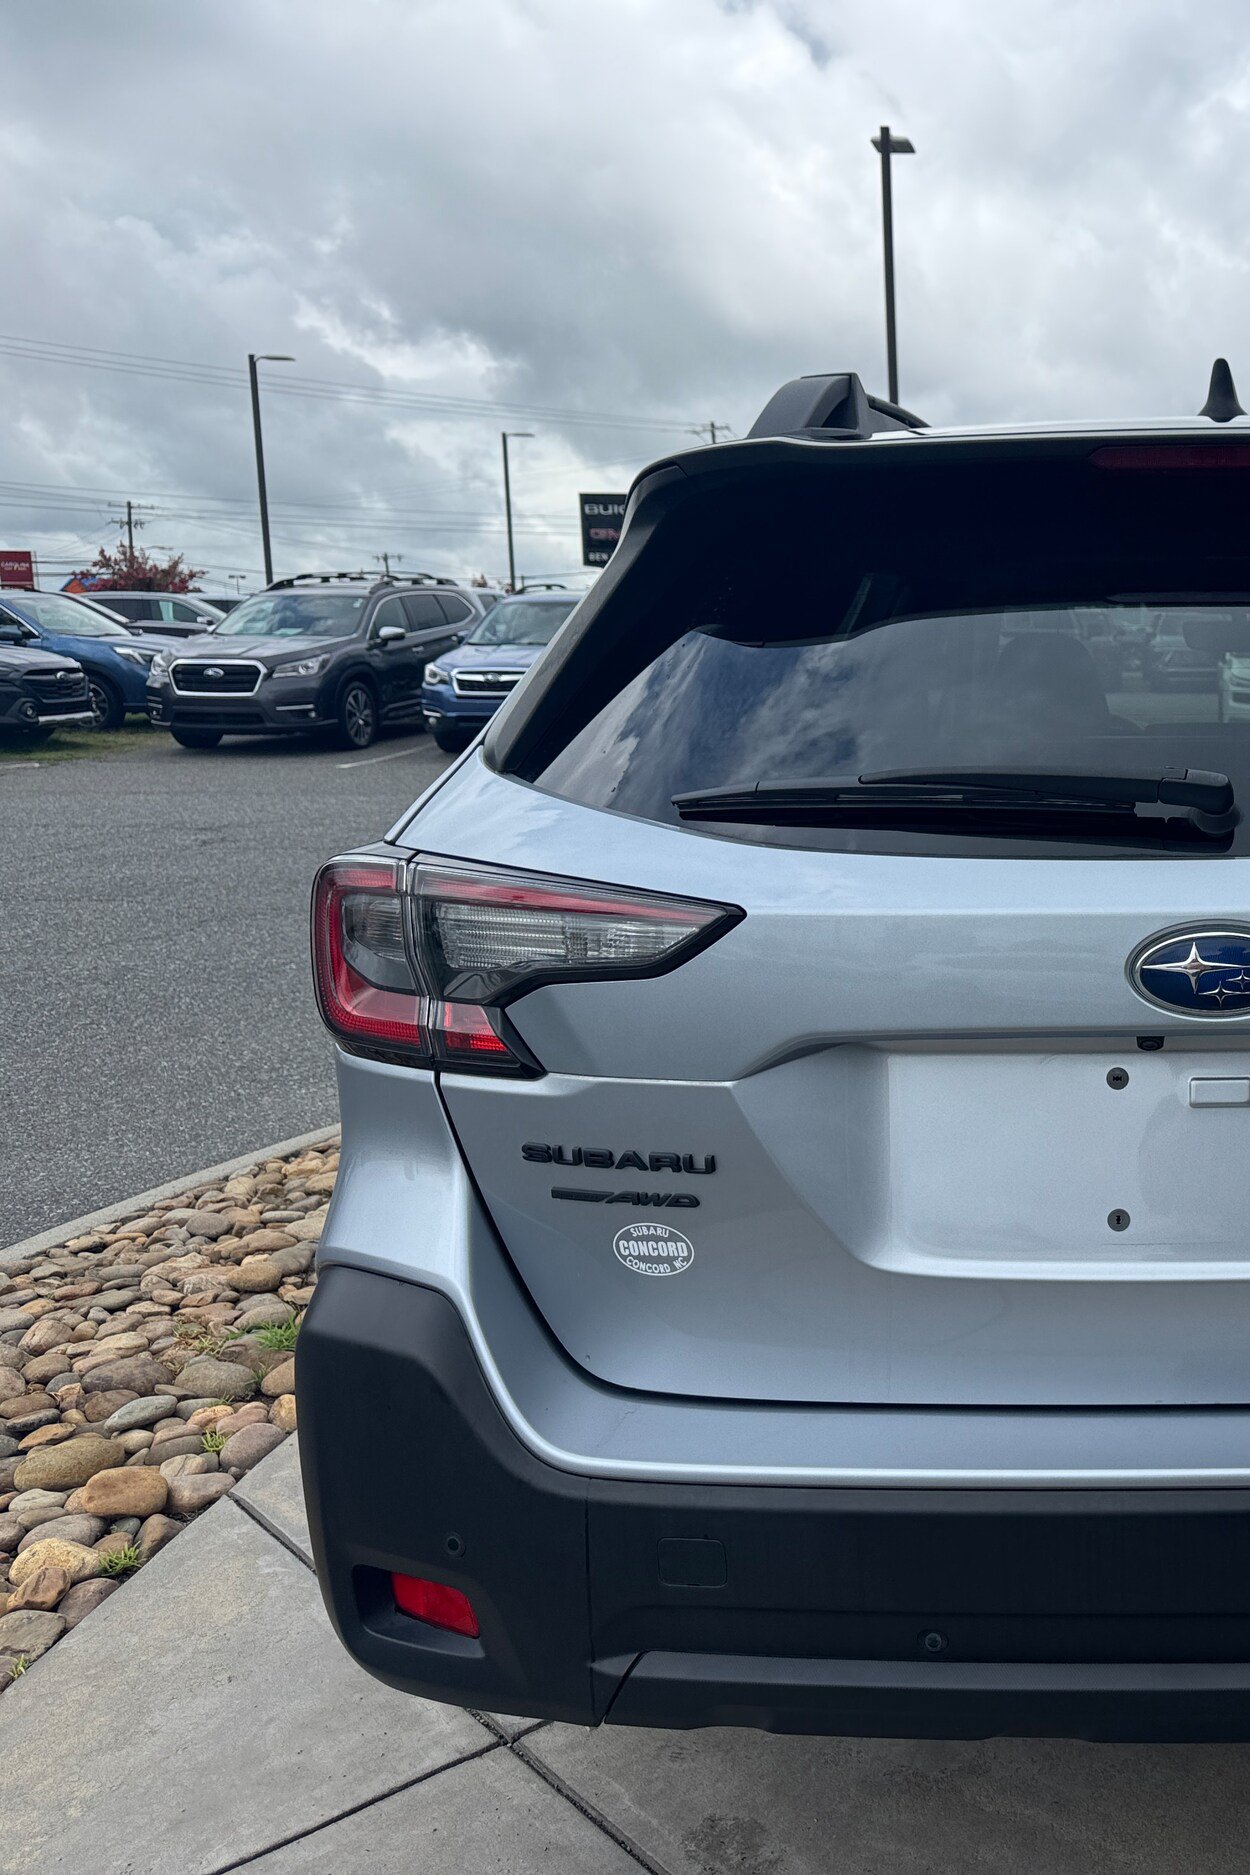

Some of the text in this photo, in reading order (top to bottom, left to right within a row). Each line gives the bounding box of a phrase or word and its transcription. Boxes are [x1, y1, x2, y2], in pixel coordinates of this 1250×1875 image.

[521, 1141, 717, 1175] SUBARU
[605, 1190, 700, 1208] AWD
[630, 1226, 669, 1238] SUBARU
[619, 1240, 688, 1257] CONCORD
[626, 1256, 687, 1274] CONCORD NC
